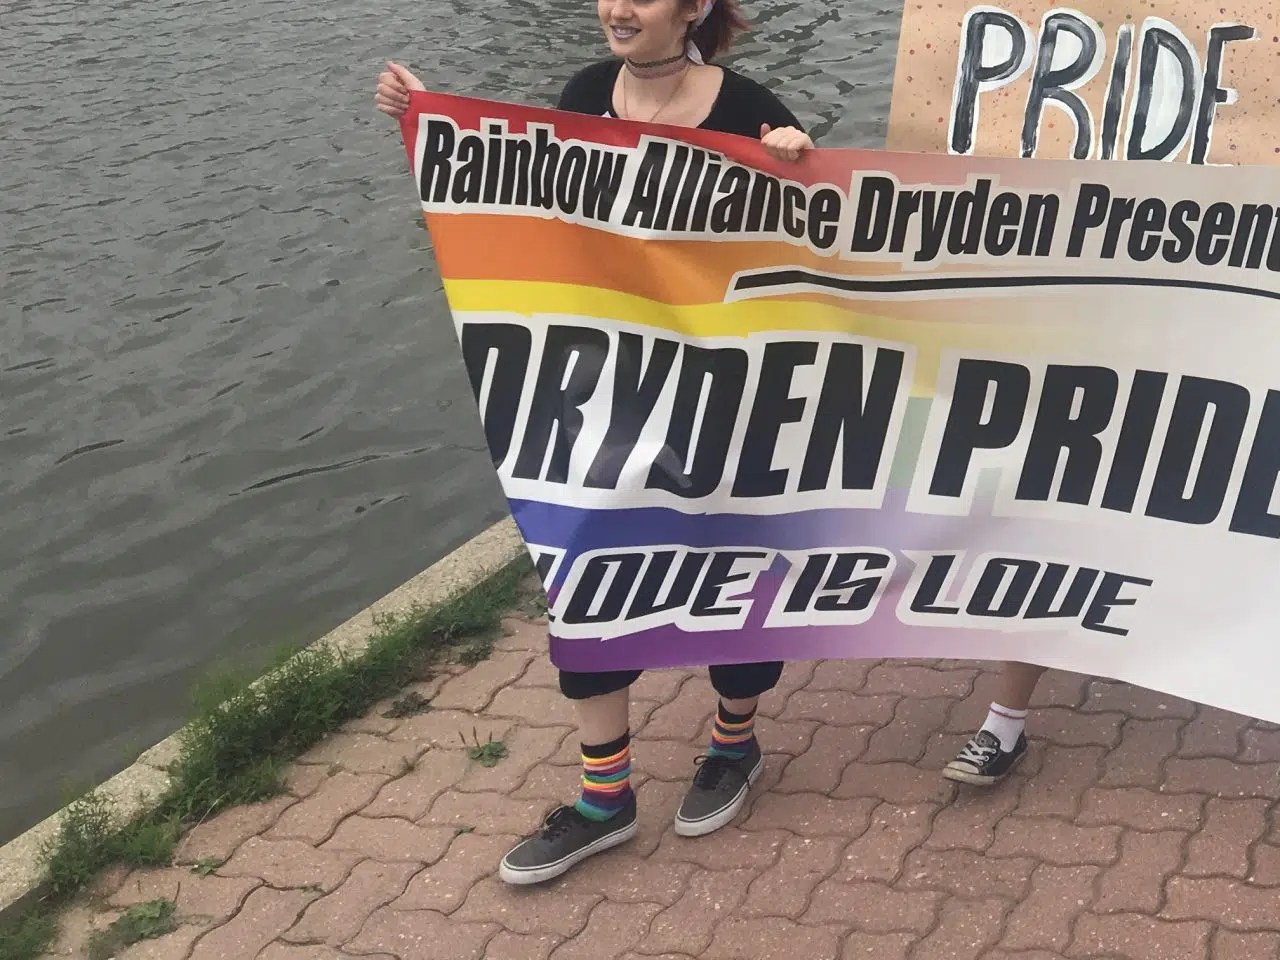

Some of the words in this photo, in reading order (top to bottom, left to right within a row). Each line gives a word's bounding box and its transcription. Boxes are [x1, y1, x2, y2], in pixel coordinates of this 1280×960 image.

[949, 7, 1259, 165] PRIDE
[421, 119, 628, 222] Rainbow
[621, 141, 842, 250] Alliance
[849, 175, 1061, 262] Dryden
[461, 322, 905, 499] DRYDEN
[782, 551, 892, 613] IS
[909, 554, 1154, 637] LOVE
